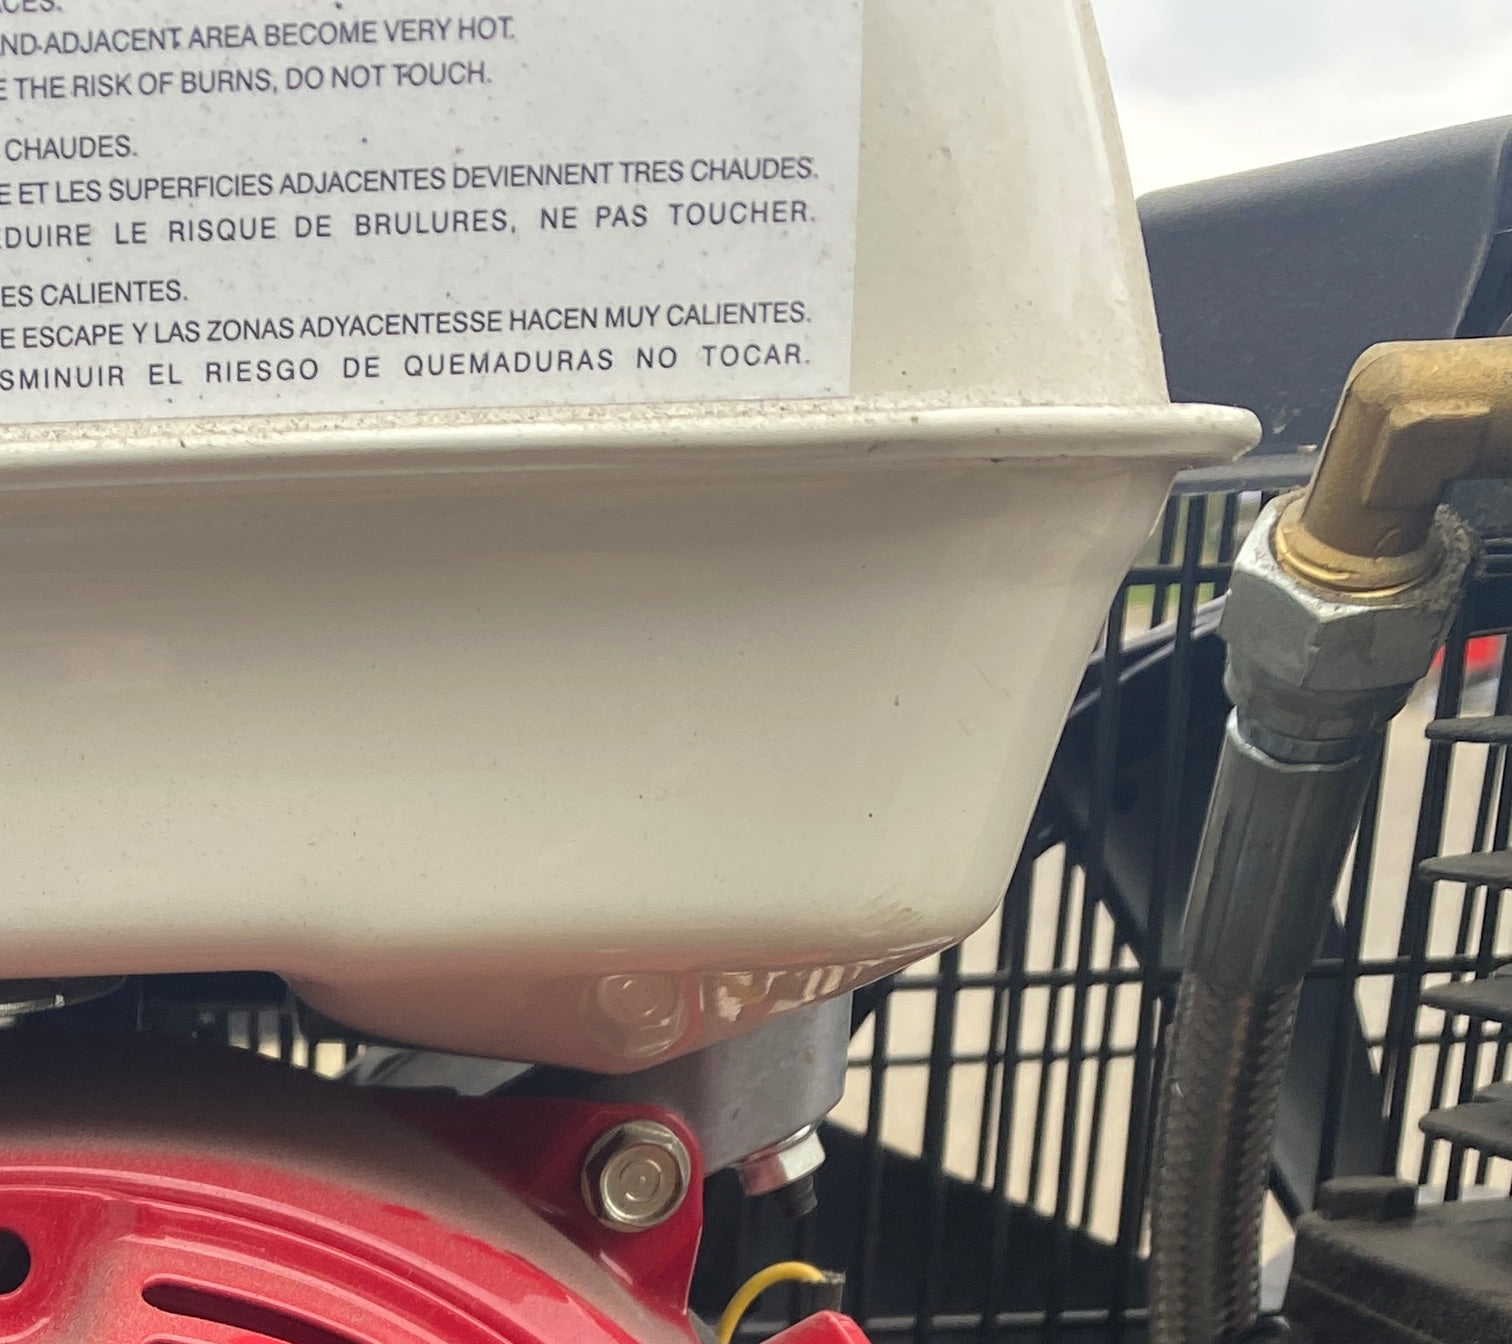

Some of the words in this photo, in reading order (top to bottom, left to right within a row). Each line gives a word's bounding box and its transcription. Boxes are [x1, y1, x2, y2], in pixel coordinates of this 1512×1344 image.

[44, 26, 182, 54] ADJACENT
[187, 25, 258, 48] AREA
[264, 20, 376, 46] BECOME
[383, 17, 451, 42] VERY
[458, 15, 514, 40] HOT.
[13, 75, 65, 99] THE
[72, 73, 132, 97] RISK
[138, 71, 173, 95] OF
[181, 67, 276, 94] BURNS,
[286, 66, 324, 90] DO
[331, 64, 385, 88] NOT
[392, 61, 491, 86] TOUCH.
[4, 134, 136, 161] CHAUDES.
[18, 181, 48, 204] ET
[55, 179, 101, 203] LES
[108, 173, 273, 201] SUPERFICIES
[279, 167, 445, 194] ADJACENTES
[453, 161, 613, 188] DEVIENNENT
[619, 160, 683, 183] TRES
[690, 156, 817, 182] CHAUDES.
[115, 221, 146, 244] LE
[169, 216, 276, 242] RISQUE
[295, 215, 331, 237] DE
[355, 208, 515, 236] BRULURES,
[540, 206, 576, 229] NE
[595, 204, 647, 227] PAS
[668, 200, 814, 225] TOUCHER.
[40, 279, 187, 306] CALIENTES.
[22, 323, 123, 348] ESCAPE
[132, 322, 147, 343] Y
[154, 320, 200, 343] LAS
[206, 317, 294, 341] ZONAS
[509, 307, 597, 330] HACEN
[605, 304, 660, 328] MUY
[666, 301, 809, 326] CALIENTES.
[148, 363, 181, 385] EL
[206, 357, 318, 382] RIESGO
[343, 356, 379, 378] DE
[404, 348, 612, 376] QUEMADURAS
[636, 346, 676, 368] NO
[702, 343, 808, 366] TOCAR.
